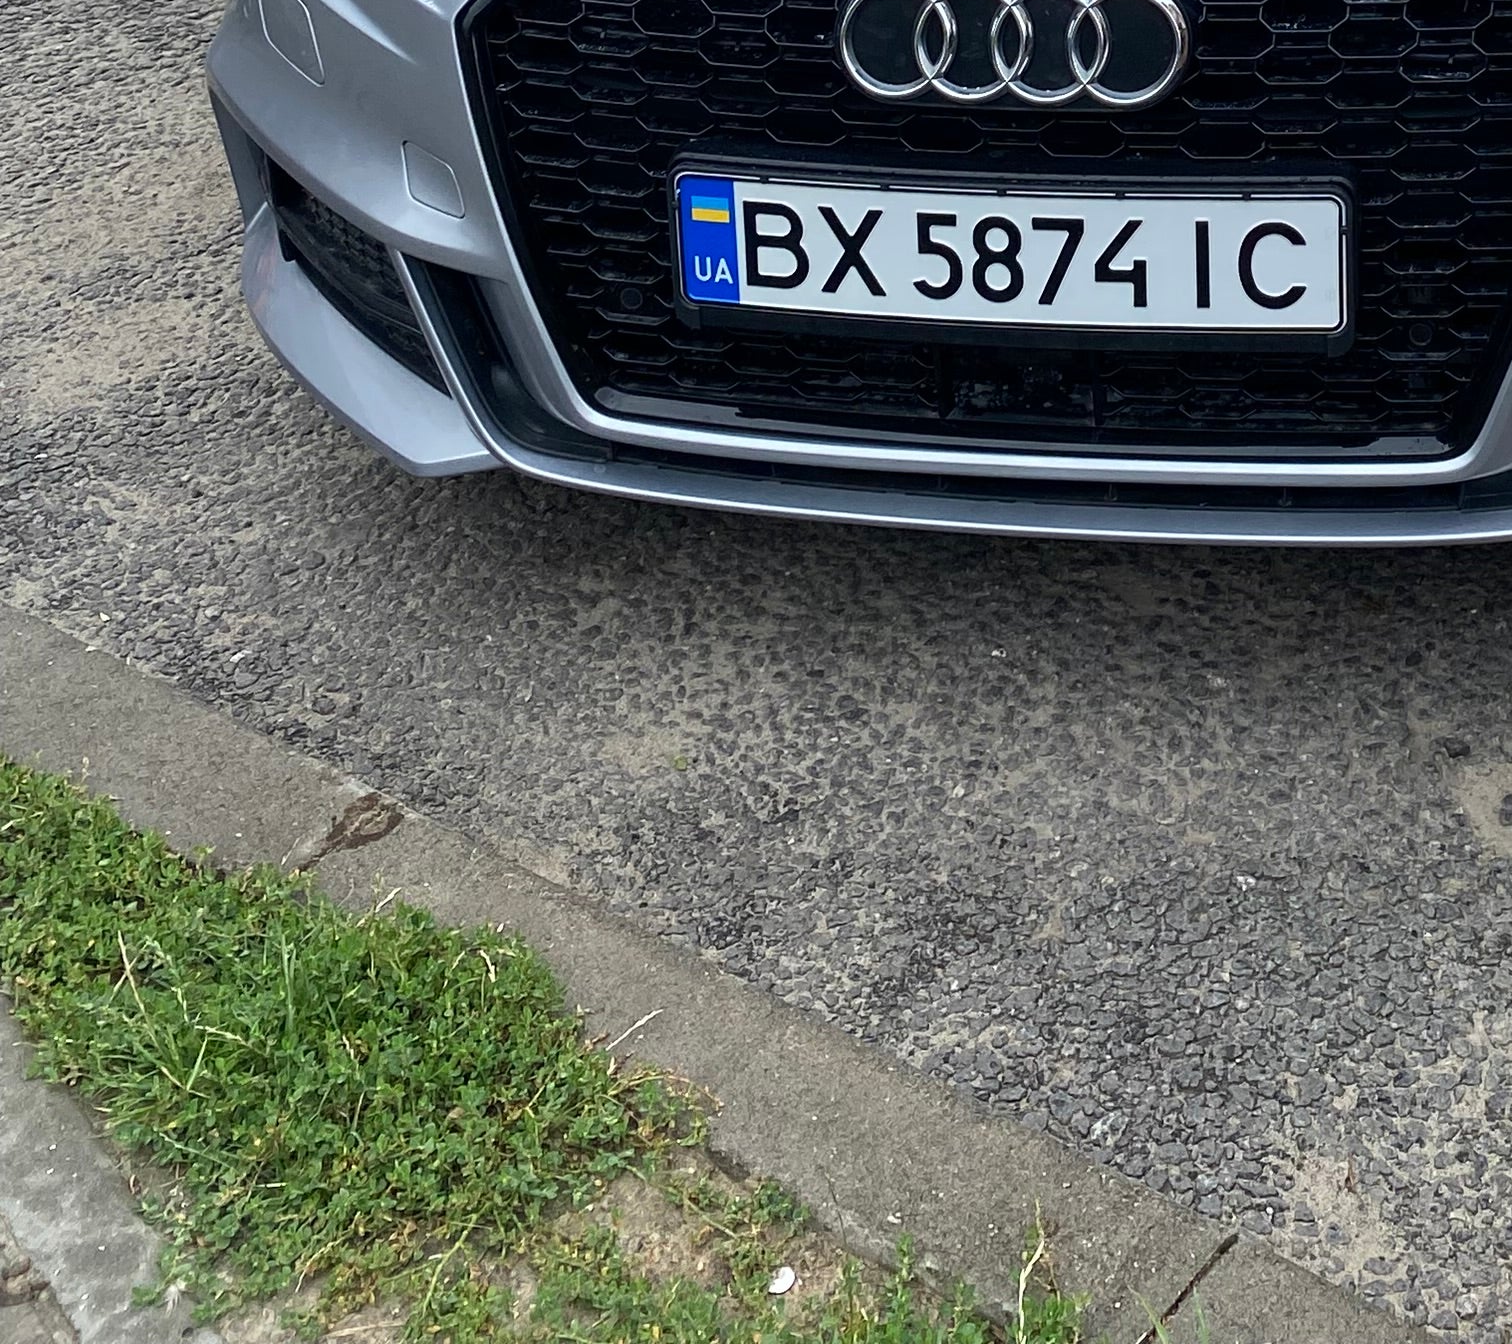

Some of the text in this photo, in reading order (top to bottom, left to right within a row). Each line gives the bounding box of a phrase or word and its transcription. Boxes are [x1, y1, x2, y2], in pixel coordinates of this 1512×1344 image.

[693, 255, 734, 286] UA
[741, 199, 1307, 310] BX 5874 IC
